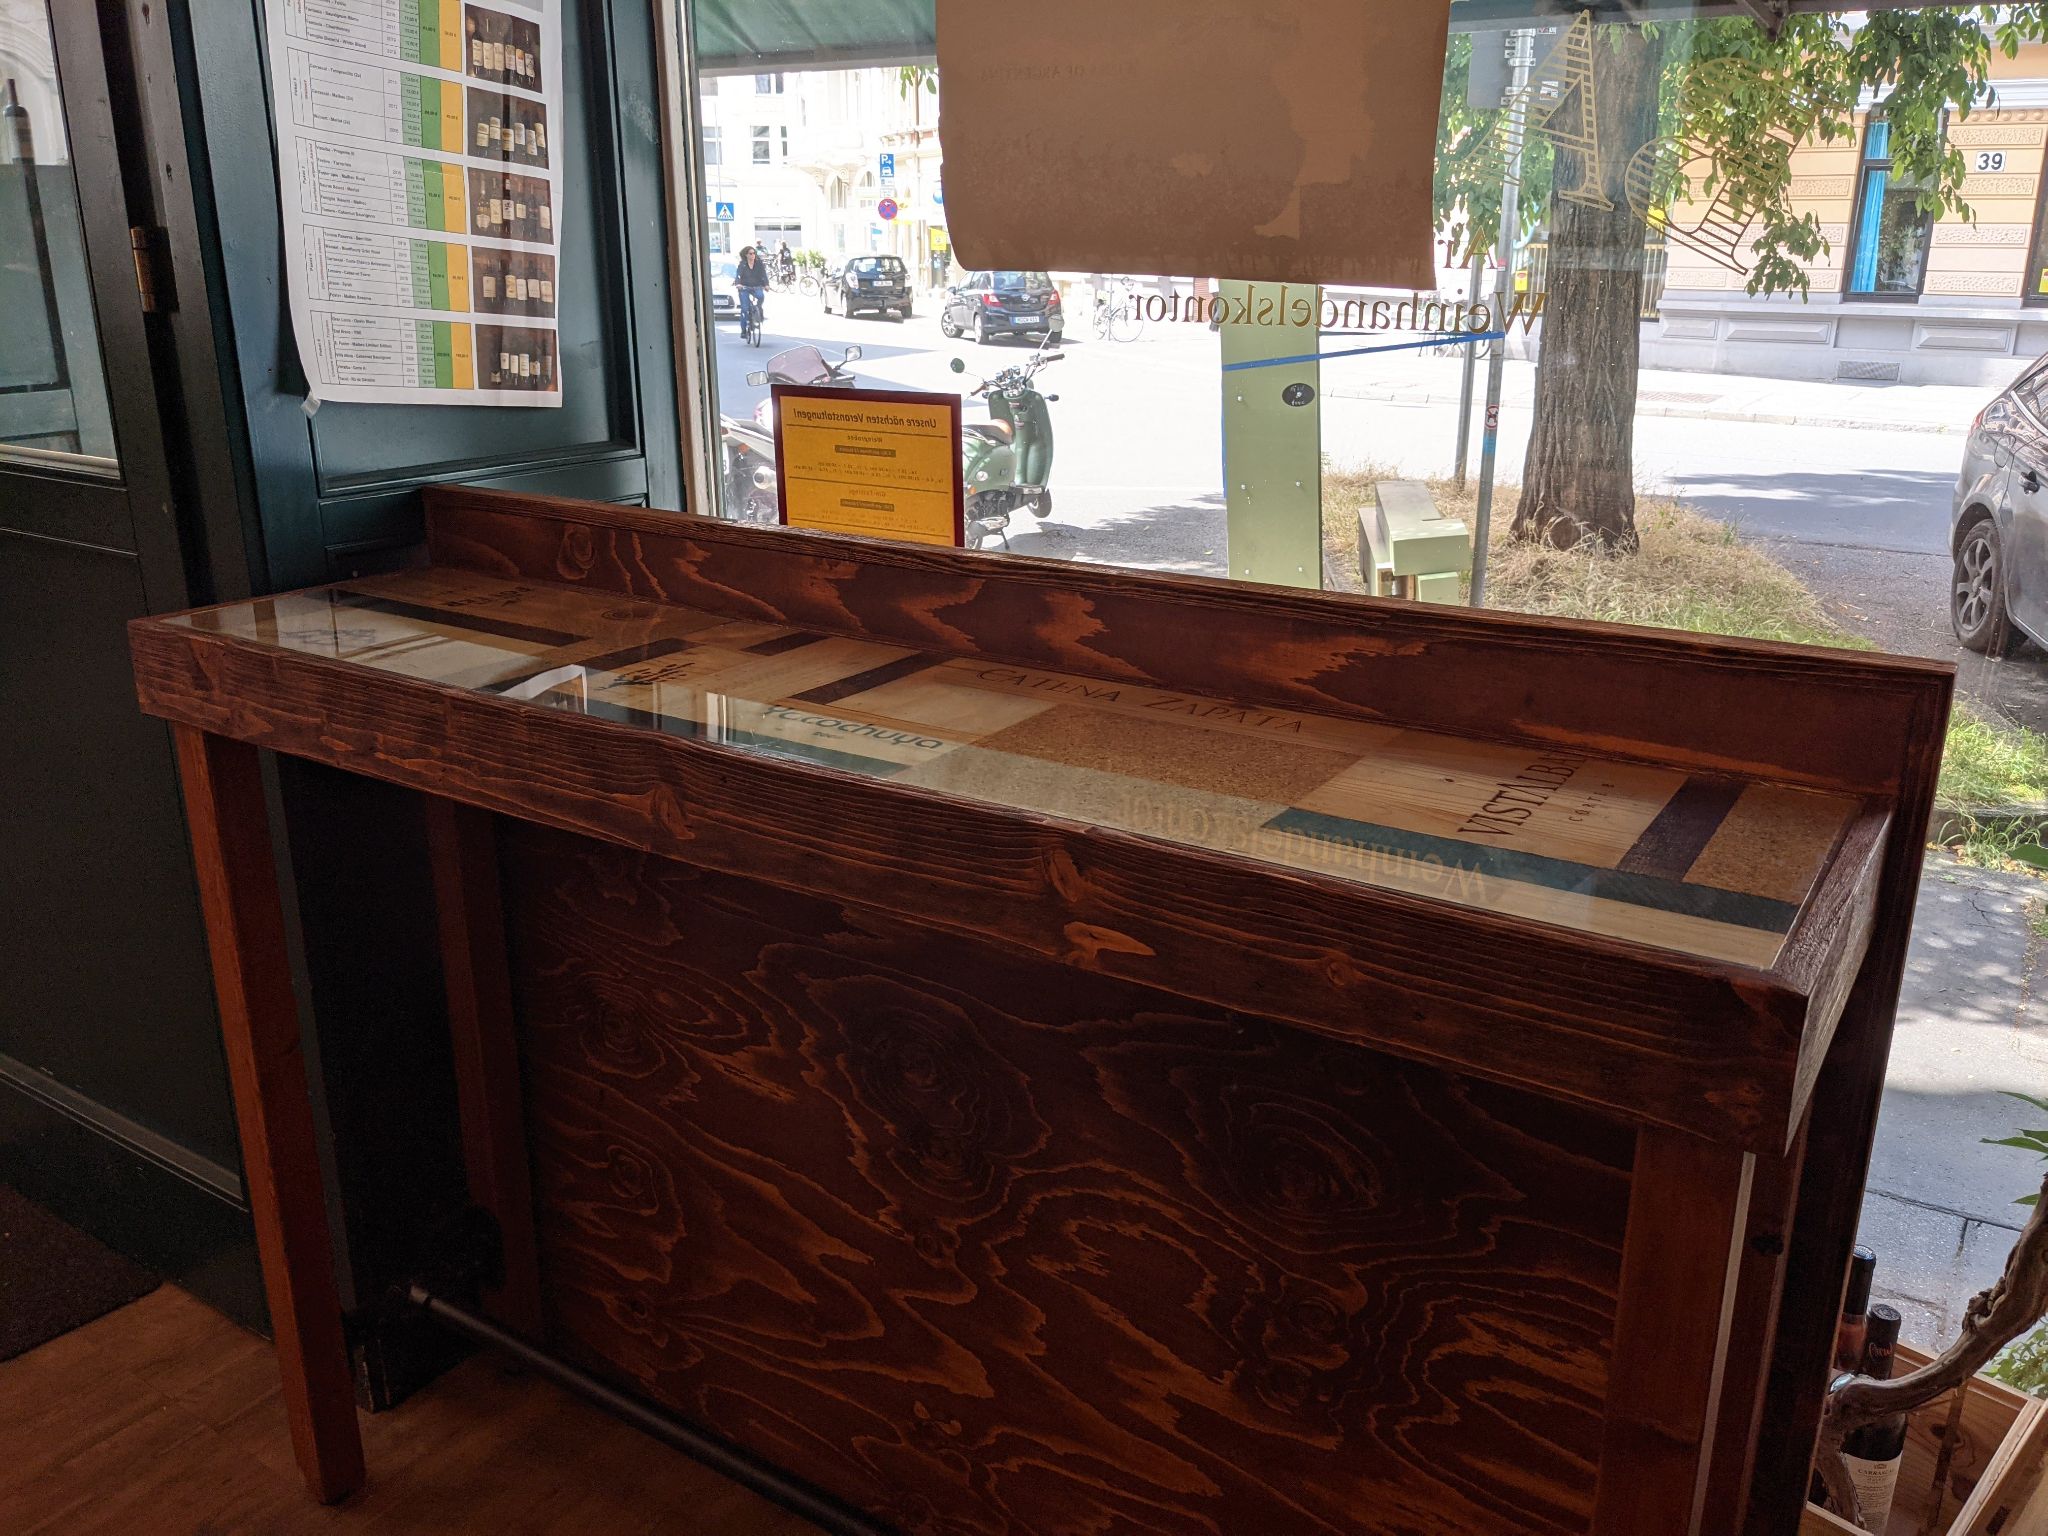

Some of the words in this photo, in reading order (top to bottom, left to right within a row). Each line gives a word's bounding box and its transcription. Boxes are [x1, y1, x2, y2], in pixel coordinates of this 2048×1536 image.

[1977, 153, 2003, 171] 39
[977, 668, 1120, 701] CATENA
[1143, 696, 1303, 733] ZAPATA
